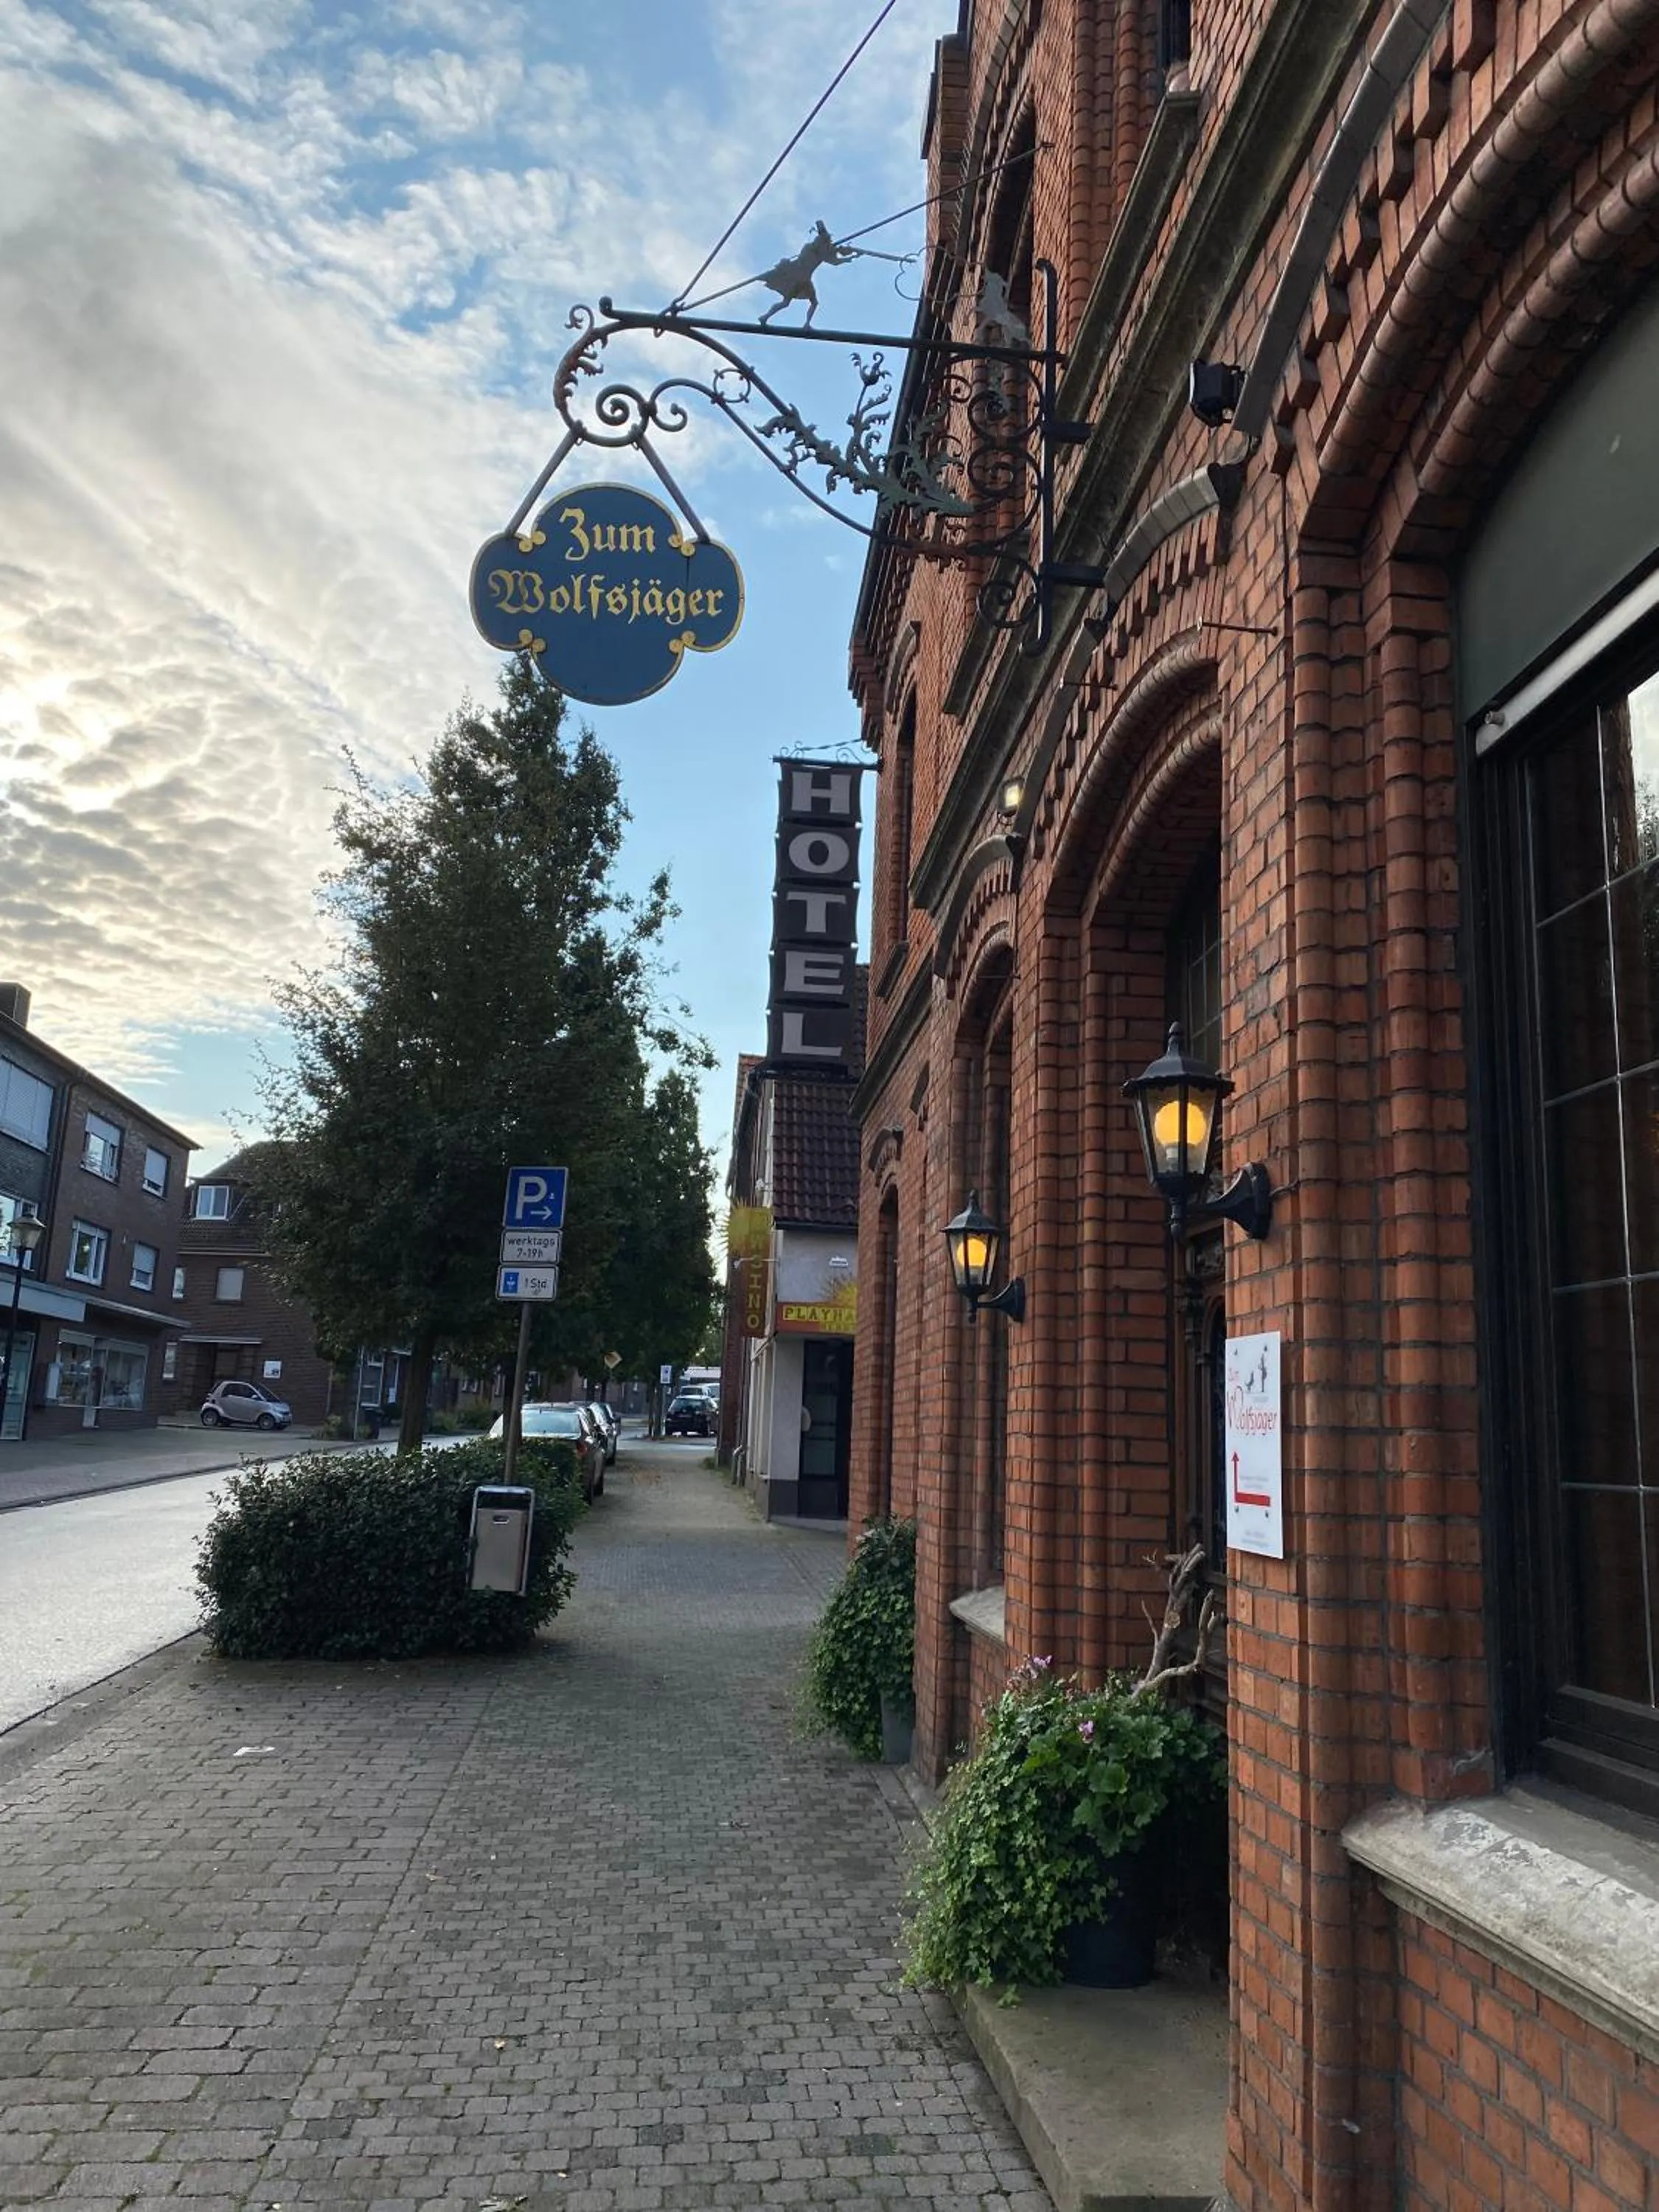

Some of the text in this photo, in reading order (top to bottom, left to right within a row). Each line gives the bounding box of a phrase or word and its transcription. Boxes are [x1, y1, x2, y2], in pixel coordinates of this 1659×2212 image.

[559, 508, 655, 561] Zum
[487, 569, 724, 625] Wolfsjäger
[781, 771, 852, 1057] HOTEL
[514, 1175, 548, 1220] P
[507, 1236, 555, 1248] werktags
